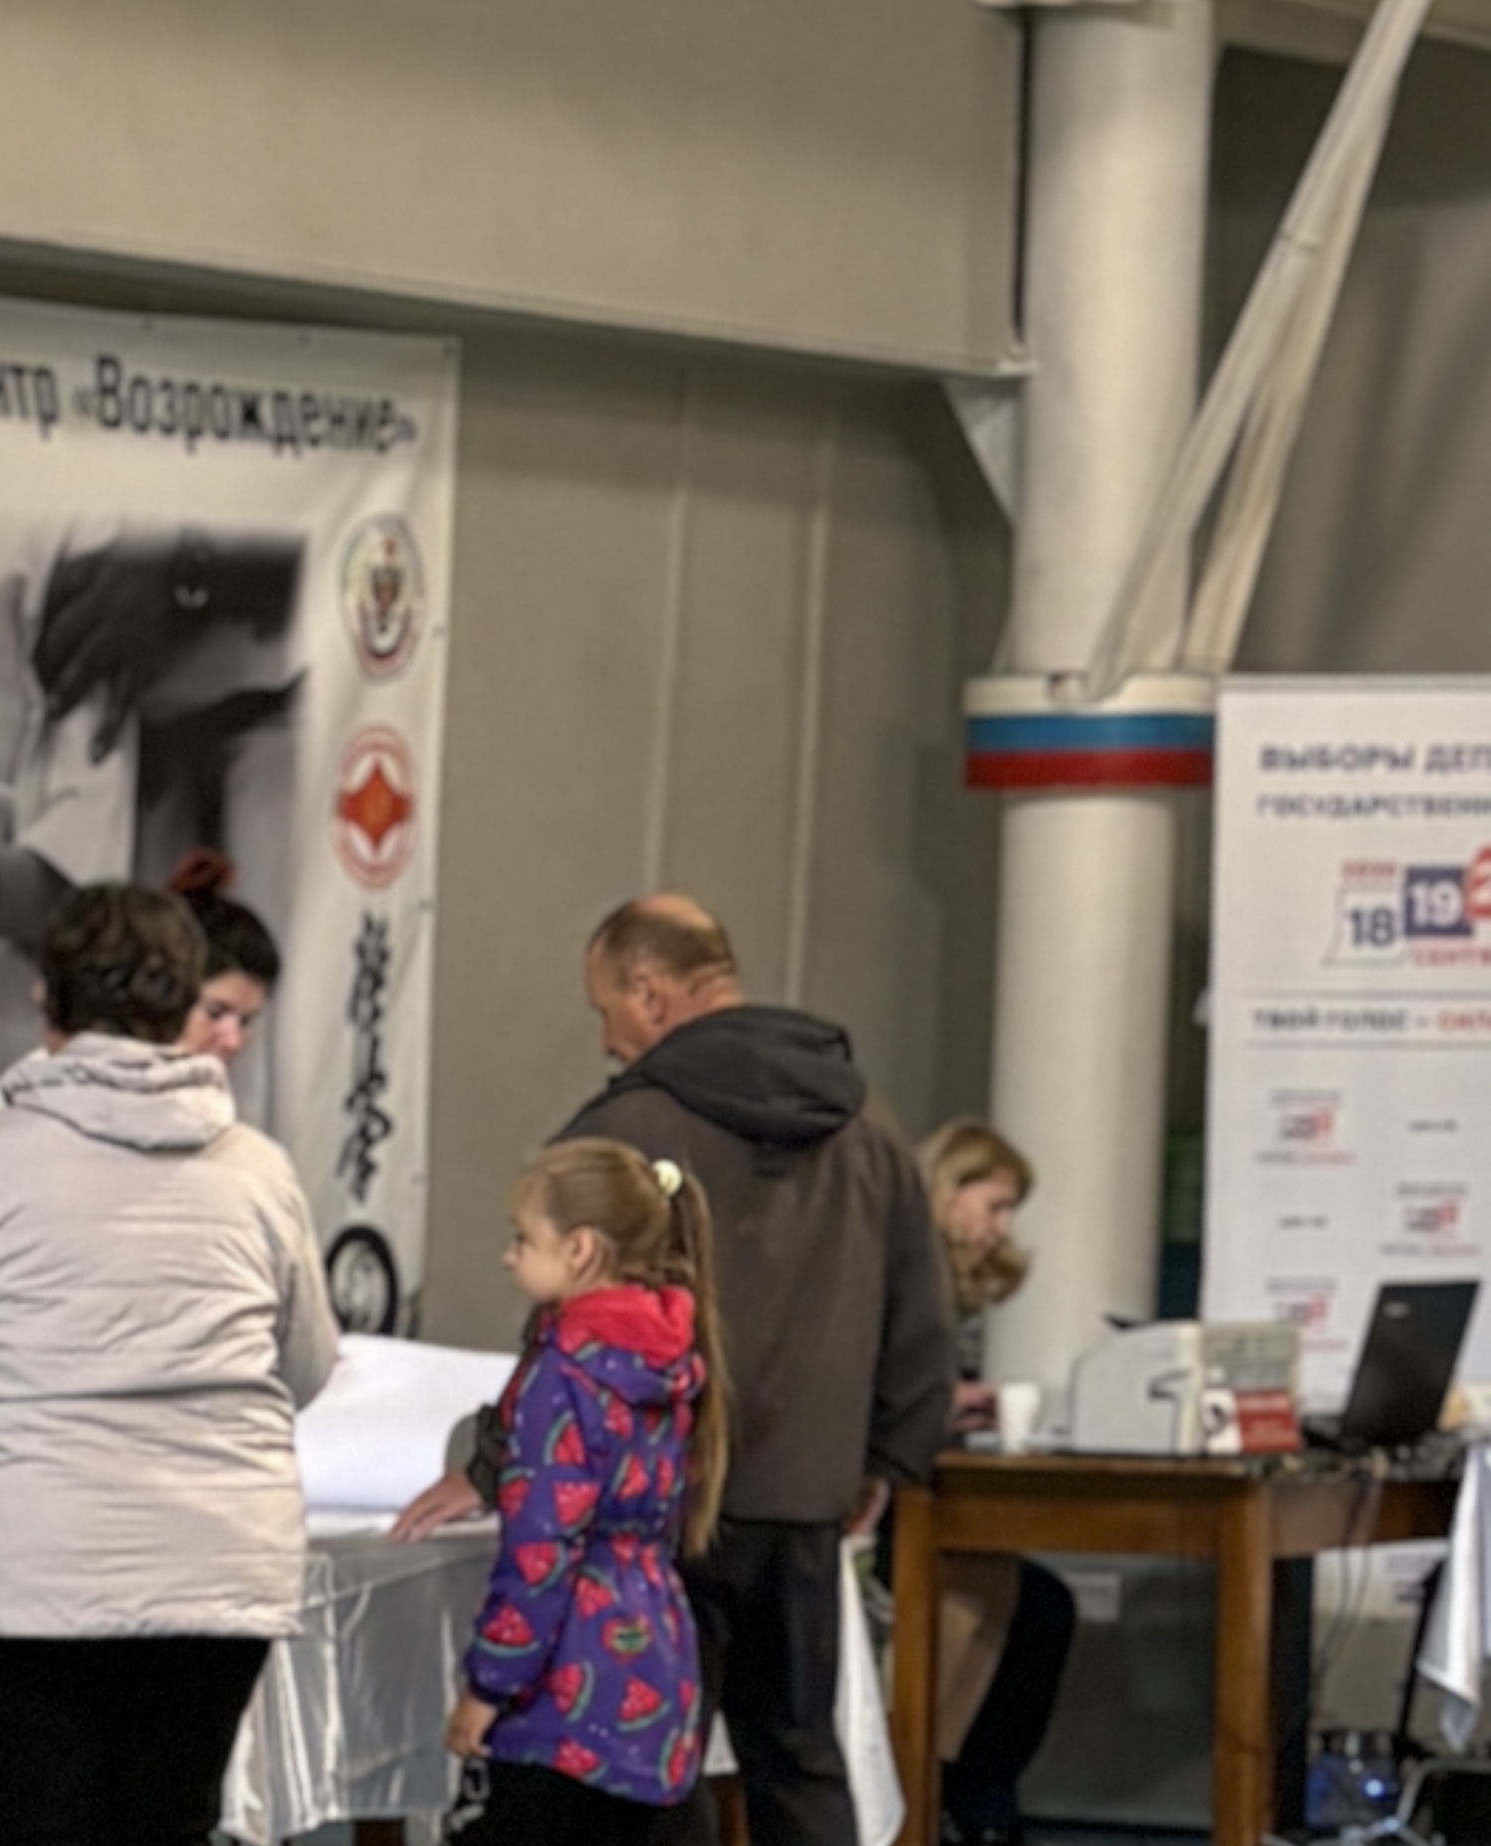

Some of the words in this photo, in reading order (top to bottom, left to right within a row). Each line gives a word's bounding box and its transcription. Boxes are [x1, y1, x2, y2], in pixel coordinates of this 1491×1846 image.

[74, 354, 416, 458] «Возрождение»
[1259, 742, 1413, 772] ВЫБОРЫ
[1349, 907, 1395, 948] 18
[1412, 879, 1461, 930] 19
